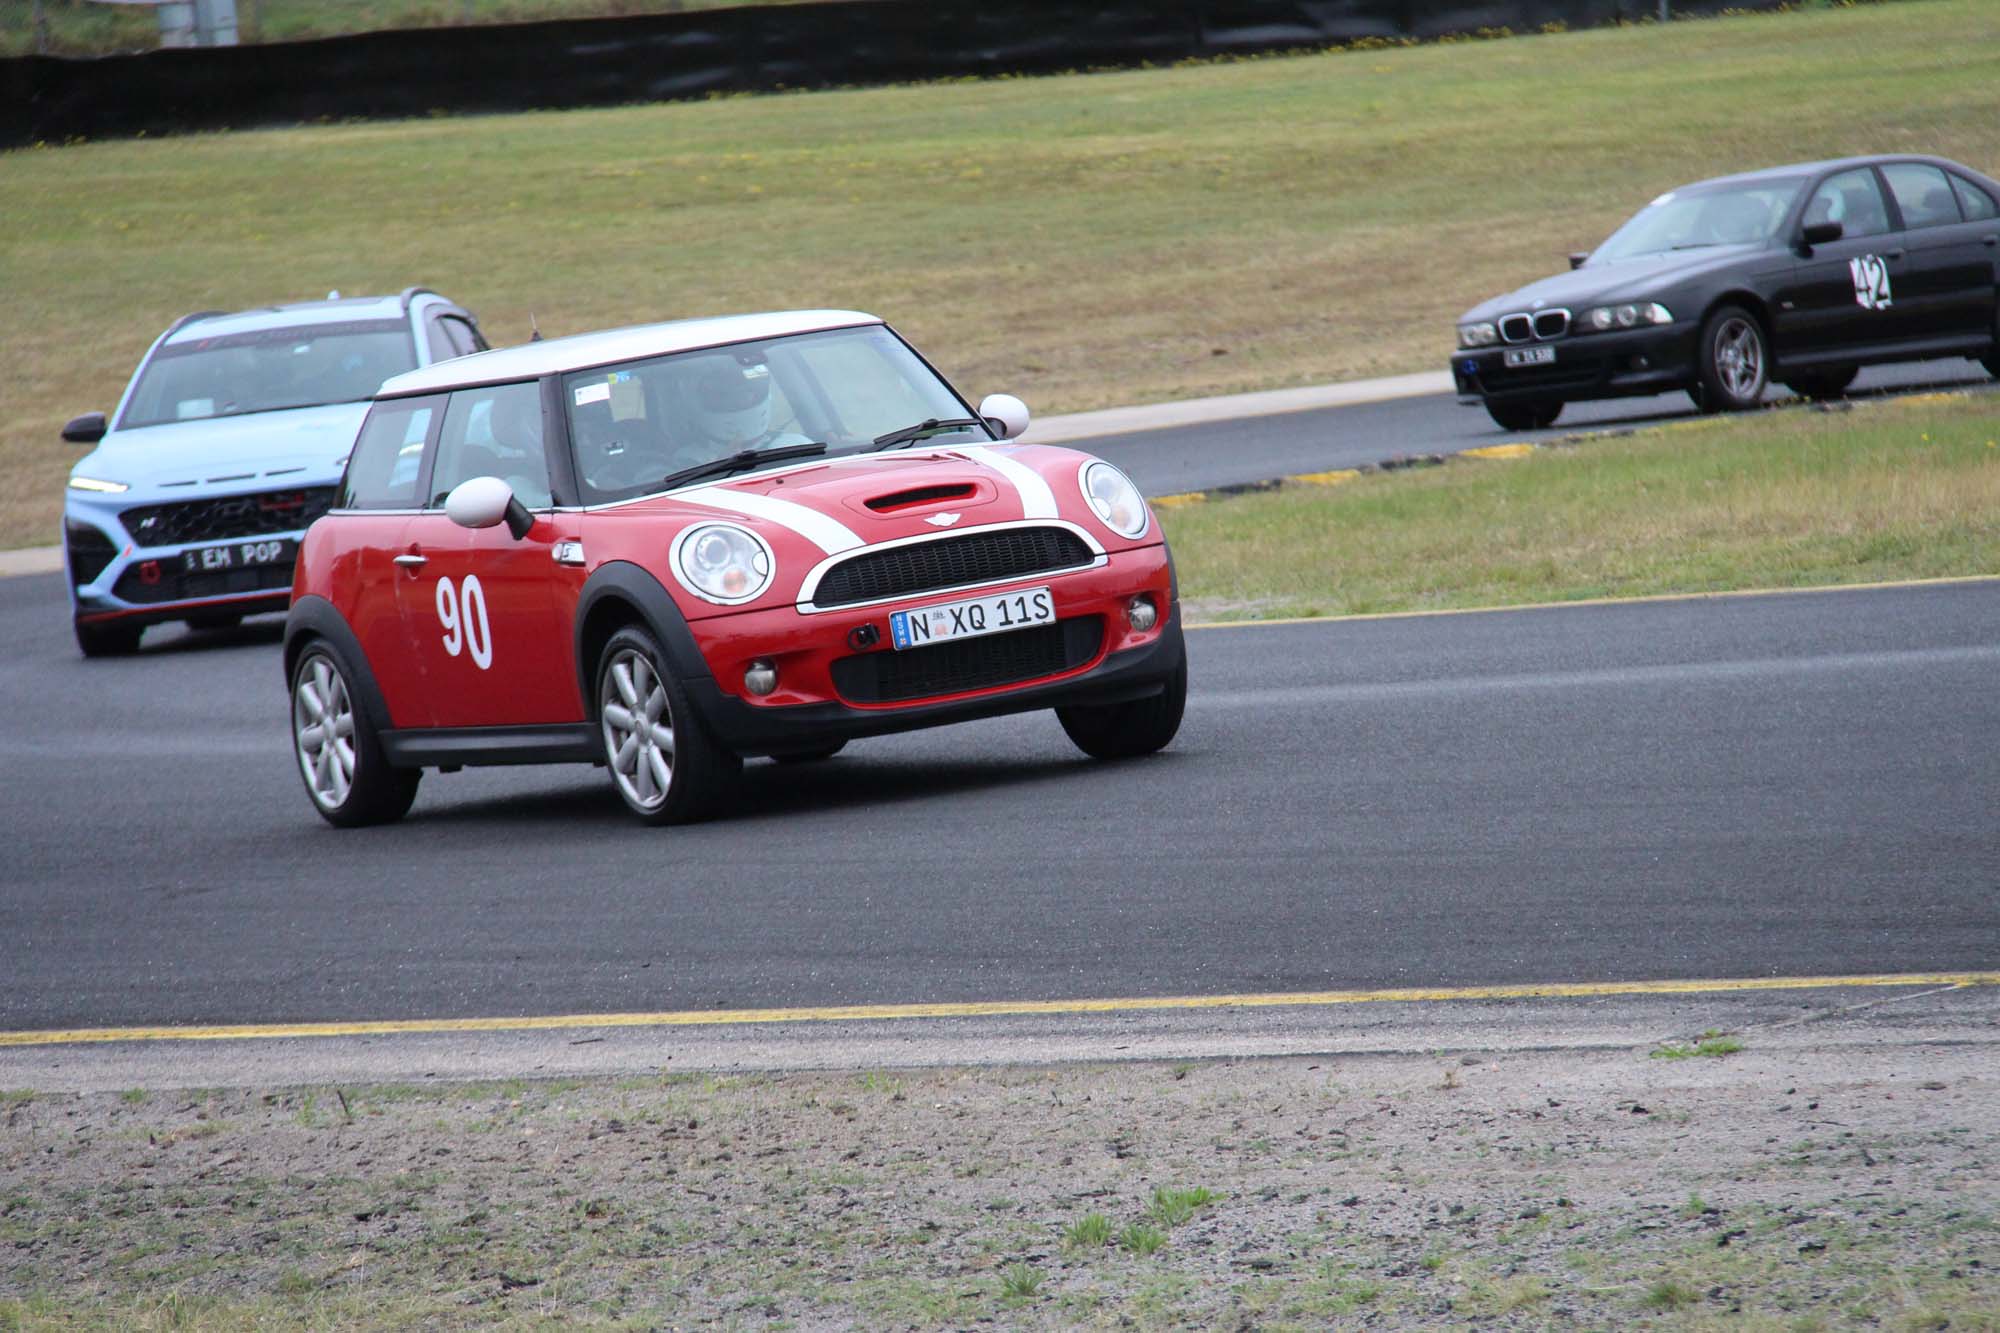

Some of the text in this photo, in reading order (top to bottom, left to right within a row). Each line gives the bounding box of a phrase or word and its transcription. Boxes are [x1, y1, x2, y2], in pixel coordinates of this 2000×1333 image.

[1850, 255, 1892, 310] 42
[242, 542, 281, 564] POP
[435, 574, 493, 670] 90
[910, 593, 1050, 642] N XQ 11S
